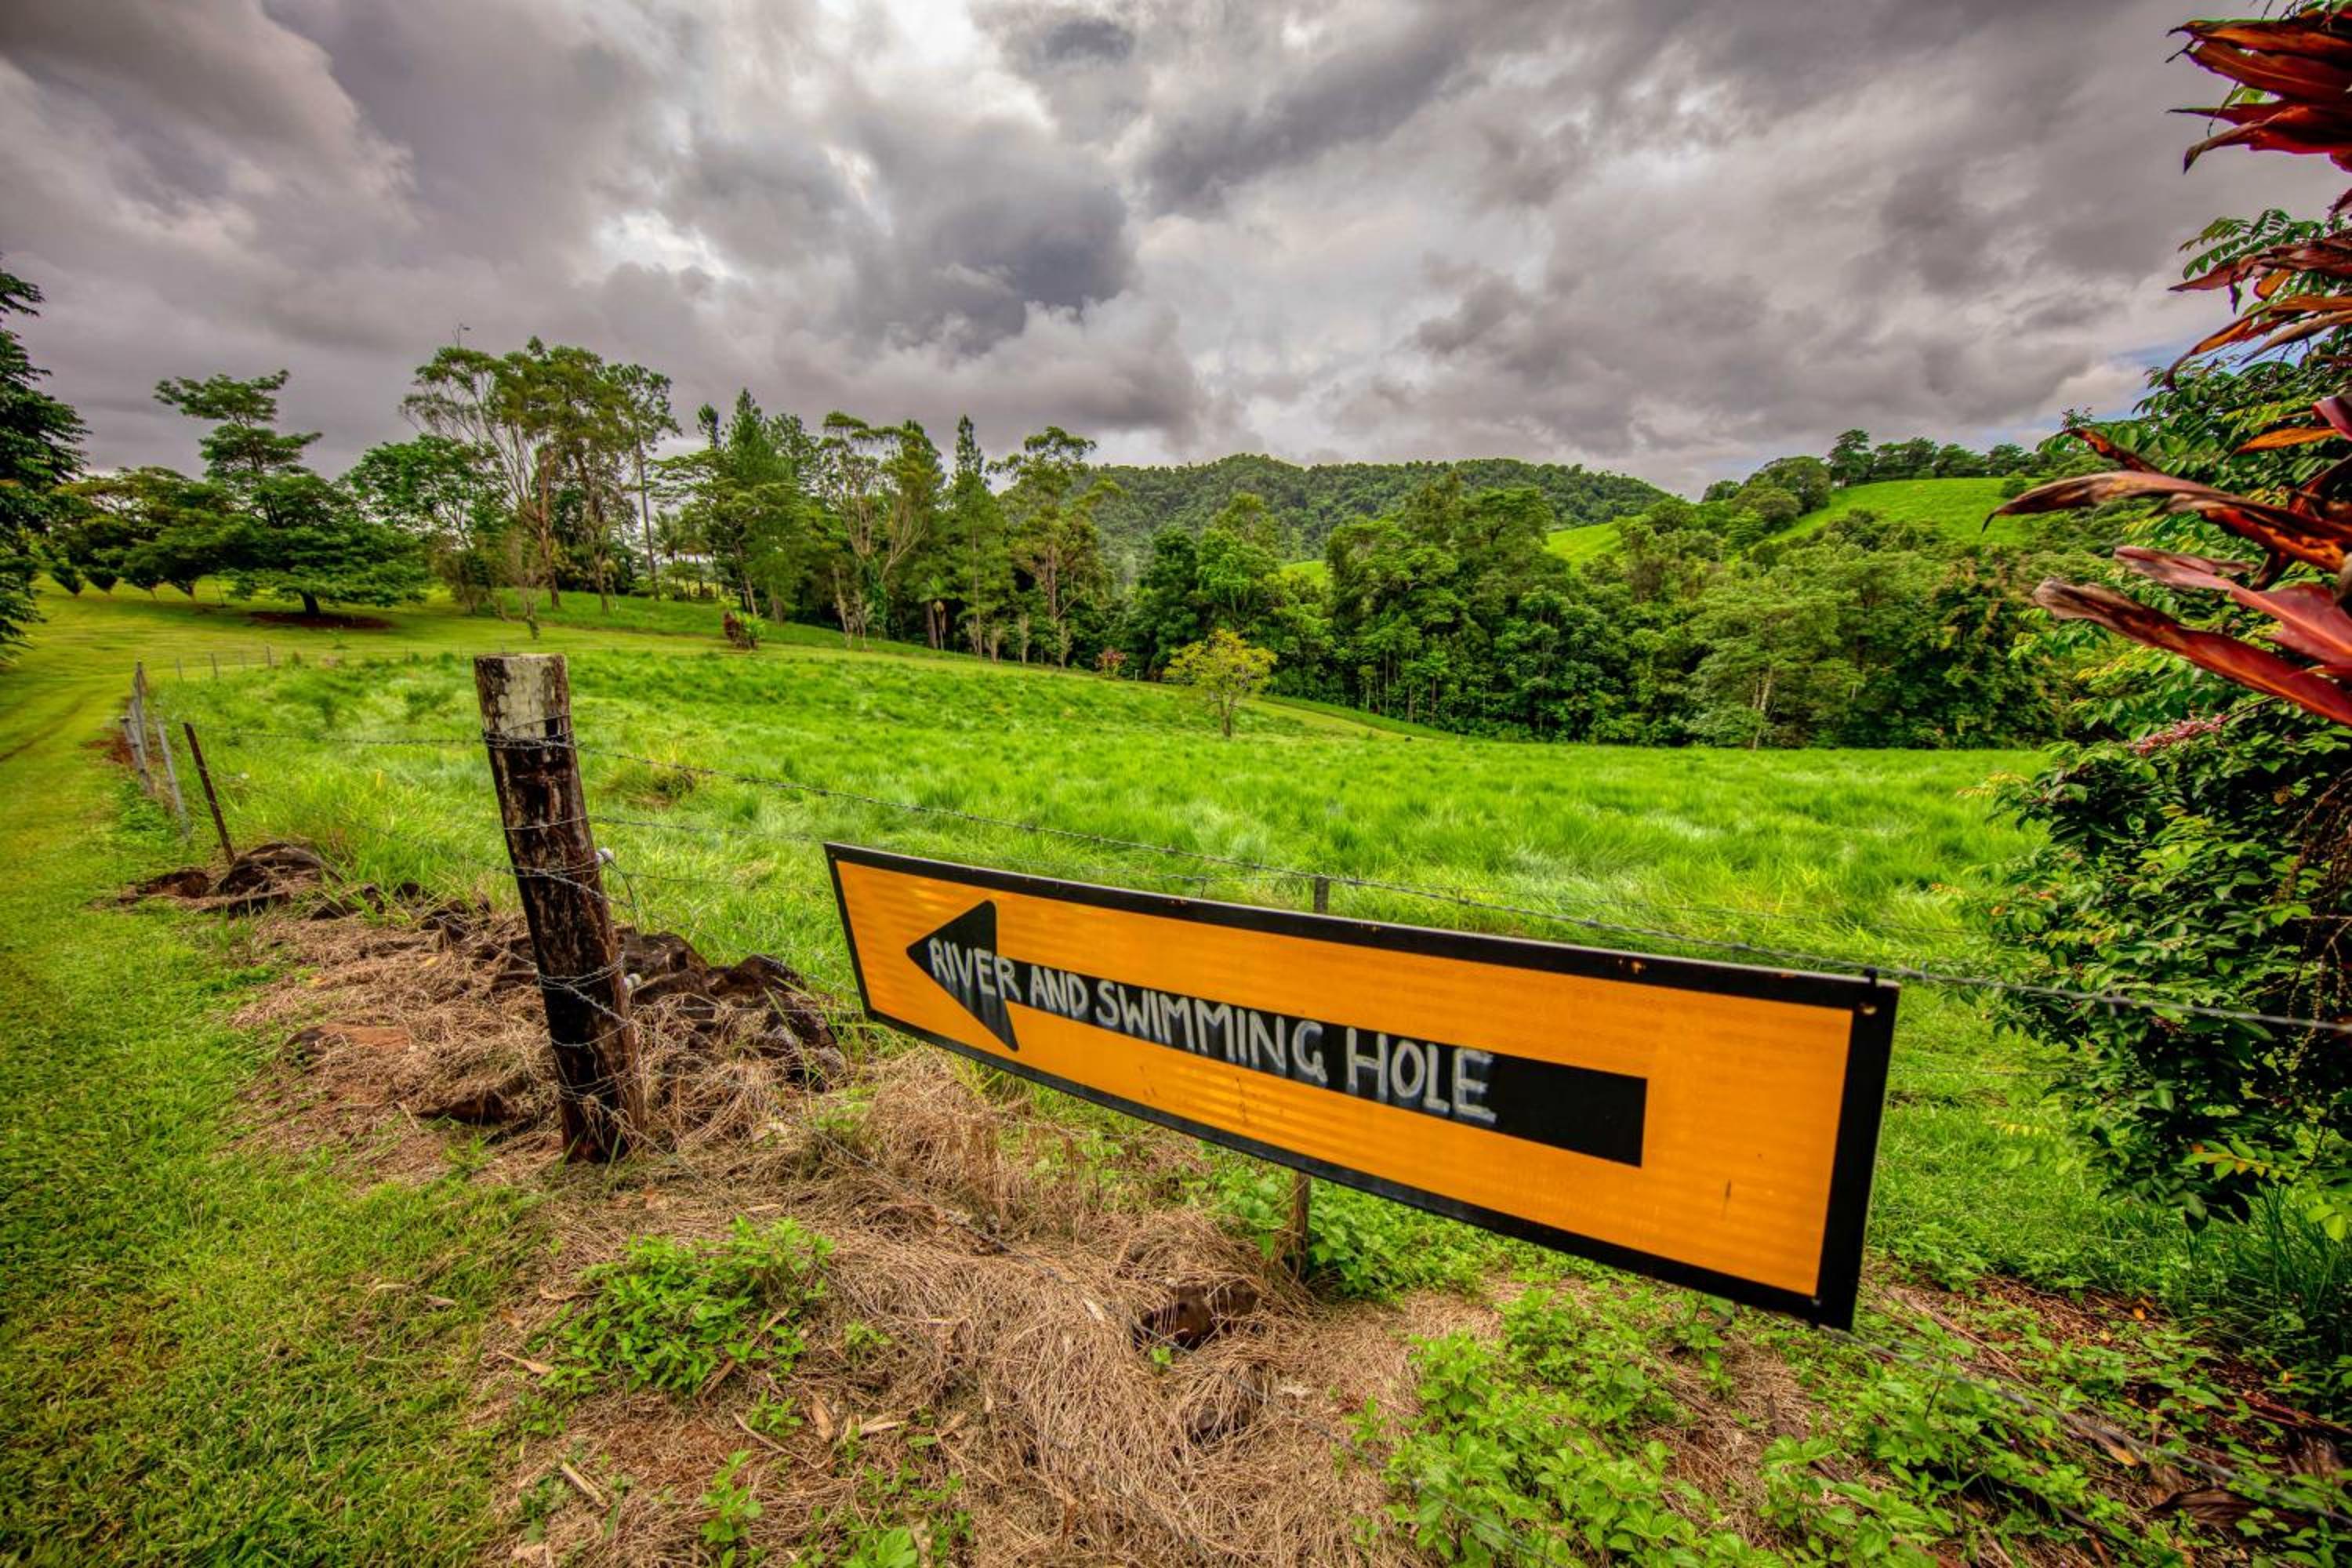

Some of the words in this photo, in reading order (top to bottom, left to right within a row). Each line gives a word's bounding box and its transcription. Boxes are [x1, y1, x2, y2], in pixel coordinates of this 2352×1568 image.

[928, 937, 1022, 1003] RIVER
[1029, 965, 1089, 1018] AND
[1095, 979, 1328, 1087] SWIMMING
[1346, 1026, 1497, 1123] HOLE
